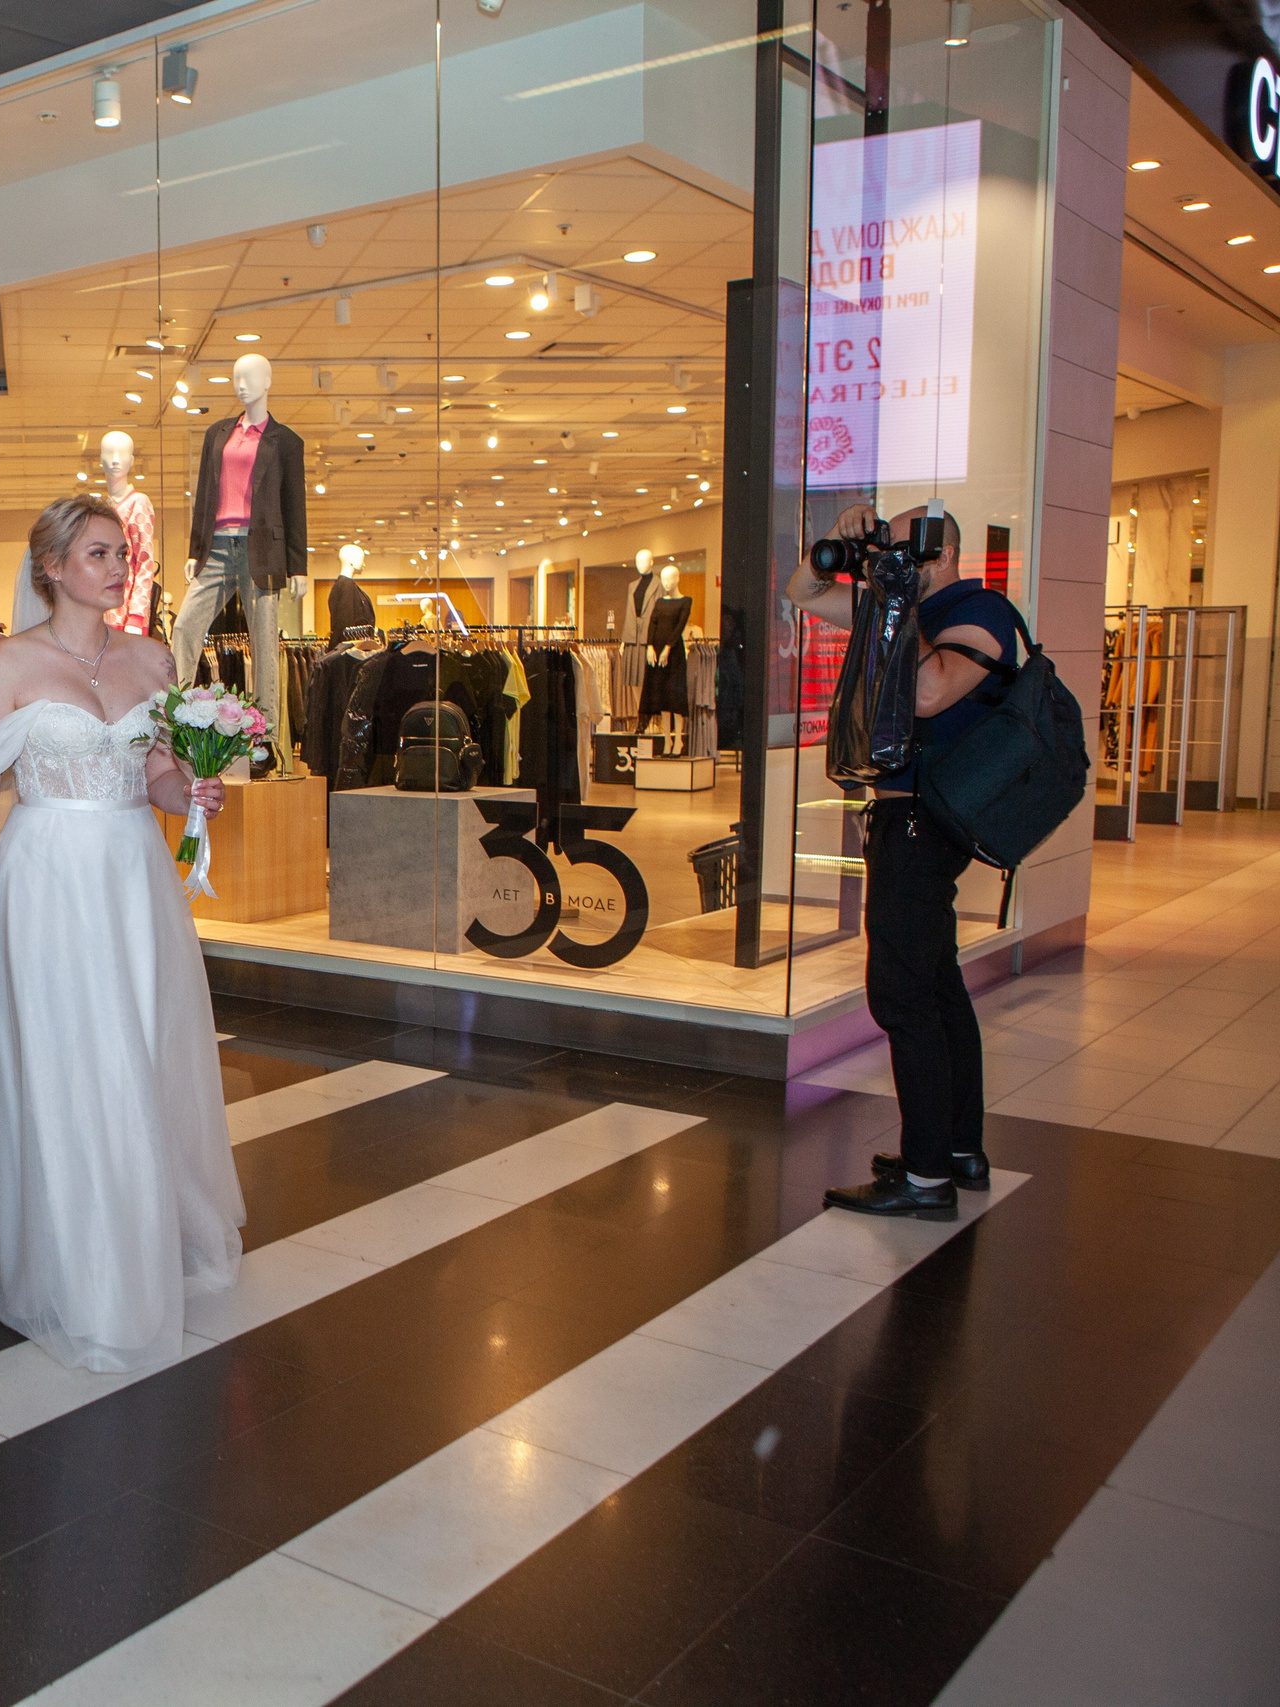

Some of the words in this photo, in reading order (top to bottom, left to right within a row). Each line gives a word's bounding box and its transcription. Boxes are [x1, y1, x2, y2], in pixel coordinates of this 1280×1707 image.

[464, 798, 649, 968] 35
[492, 888, 520, 901] ЛЕТ
[545, 892, 556, 905] В
[568, 895, 616, 912] МОДЕ
